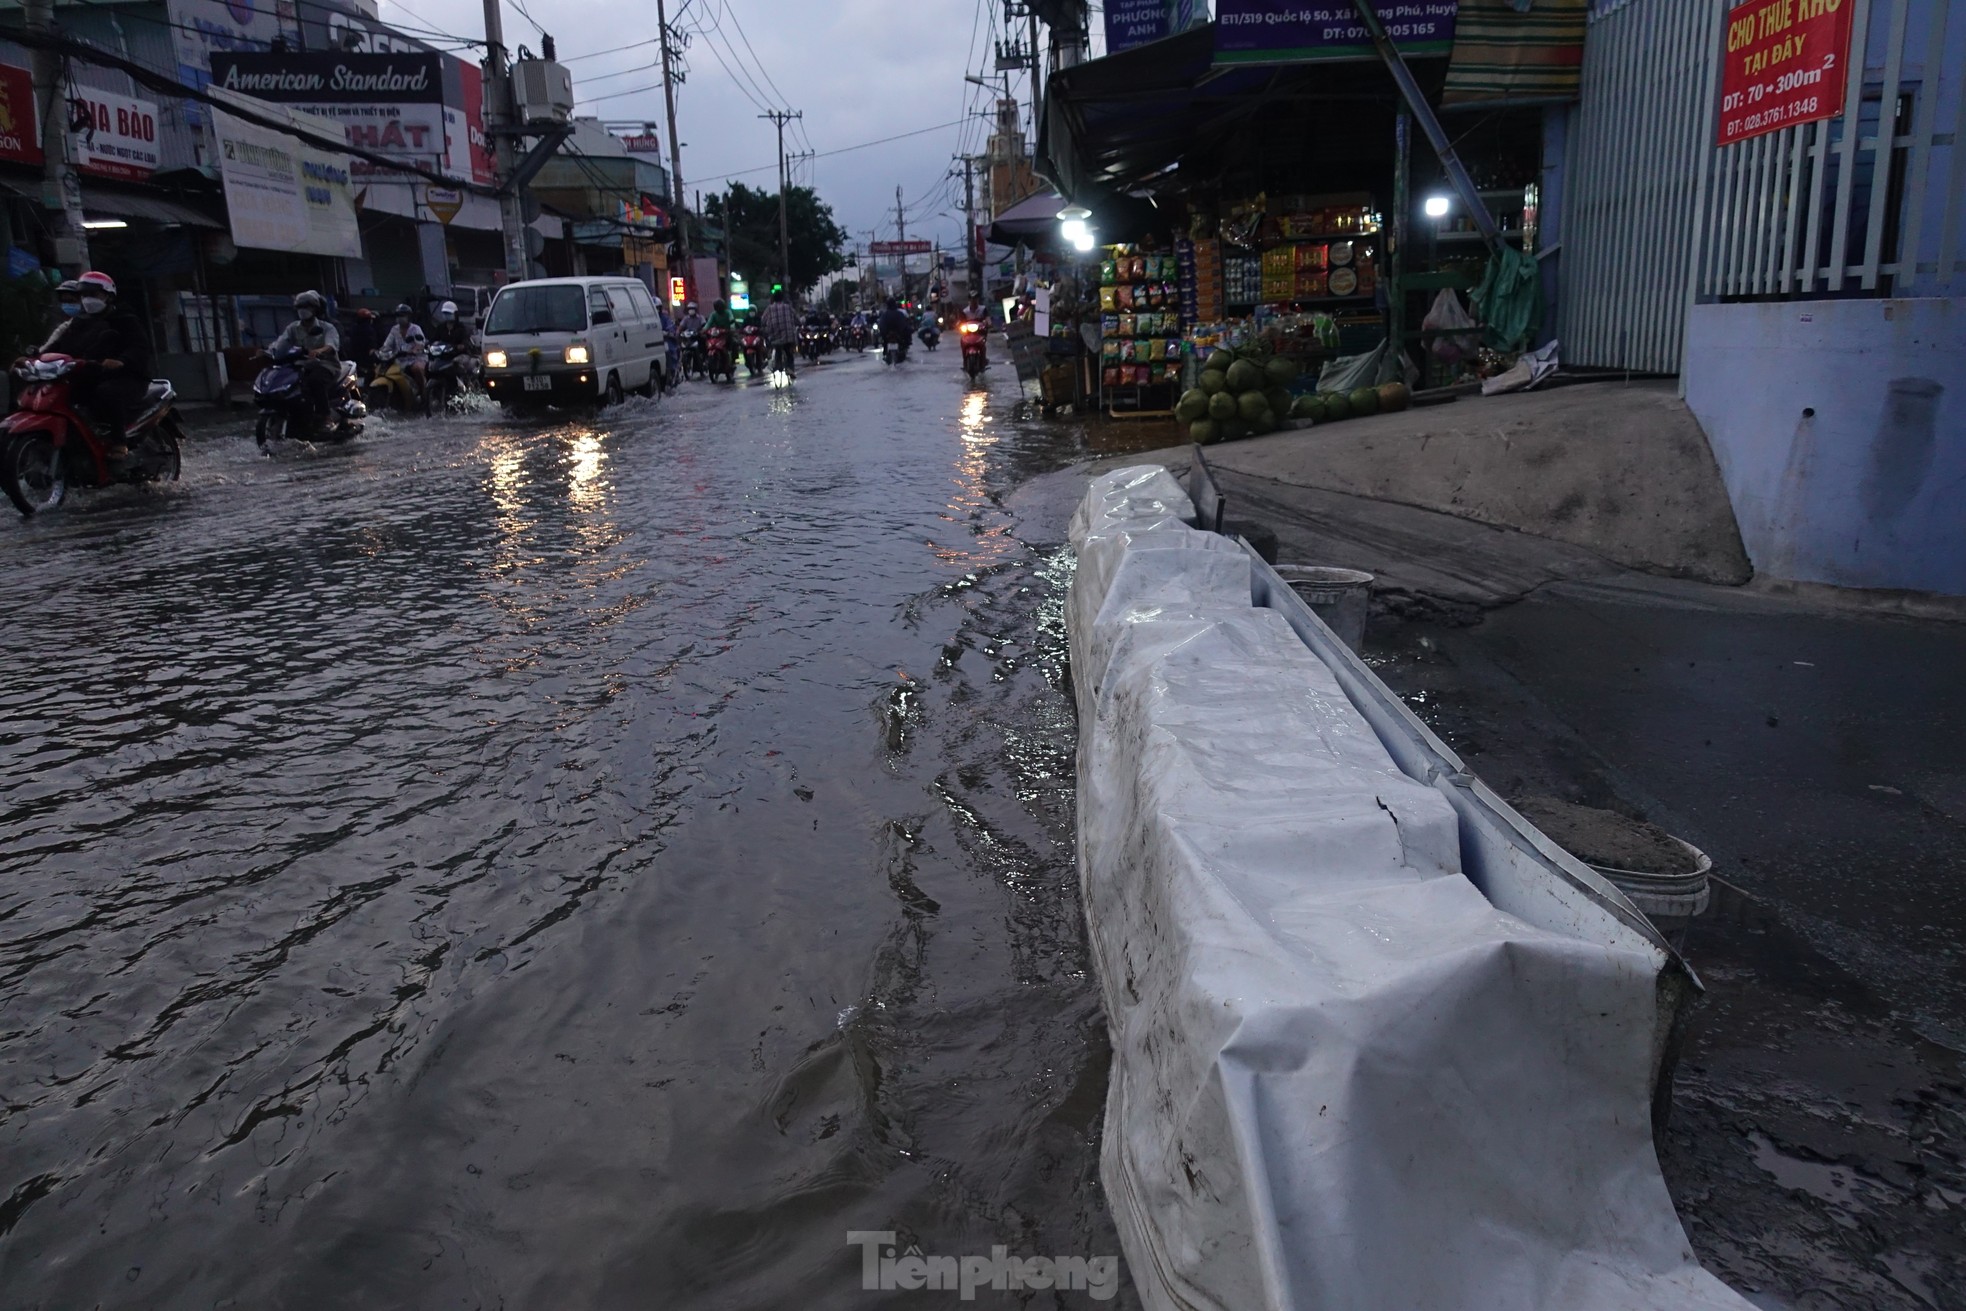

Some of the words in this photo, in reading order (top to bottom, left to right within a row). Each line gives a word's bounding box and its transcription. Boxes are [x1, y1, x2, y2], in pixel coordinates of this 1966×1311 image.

[1265, 9, 1297, 25] Quốc
[1299, 10, 1311, 25] lộ
[1313, 10, 1332, 22] 50,
[1335, 8, 1352, 21] Xã
[1396, 5, 1424, 17] Phú,
[1412, 22, 1436, 35] 165
[1127, 23, 1157, 37] ANH
[1728, 13, 1756, 53] CHO
[1743, 48, 1769, 77] TẠI
[1770, 33, 1807, 66] ĐÂY
[223, 63, 325, 90] American
[330, 64, 430, 91] Standard
[1723, 91, 1744, 113] DT:
[1747, 83, 1765, 105] 70
[117, 104, 155, 143] BẢO
[1727, 121, 1743, 137] ĐT:
[1744, 96, 1819, 131] 028.3761.1348
[347, 120, 430, 148] HÁT
